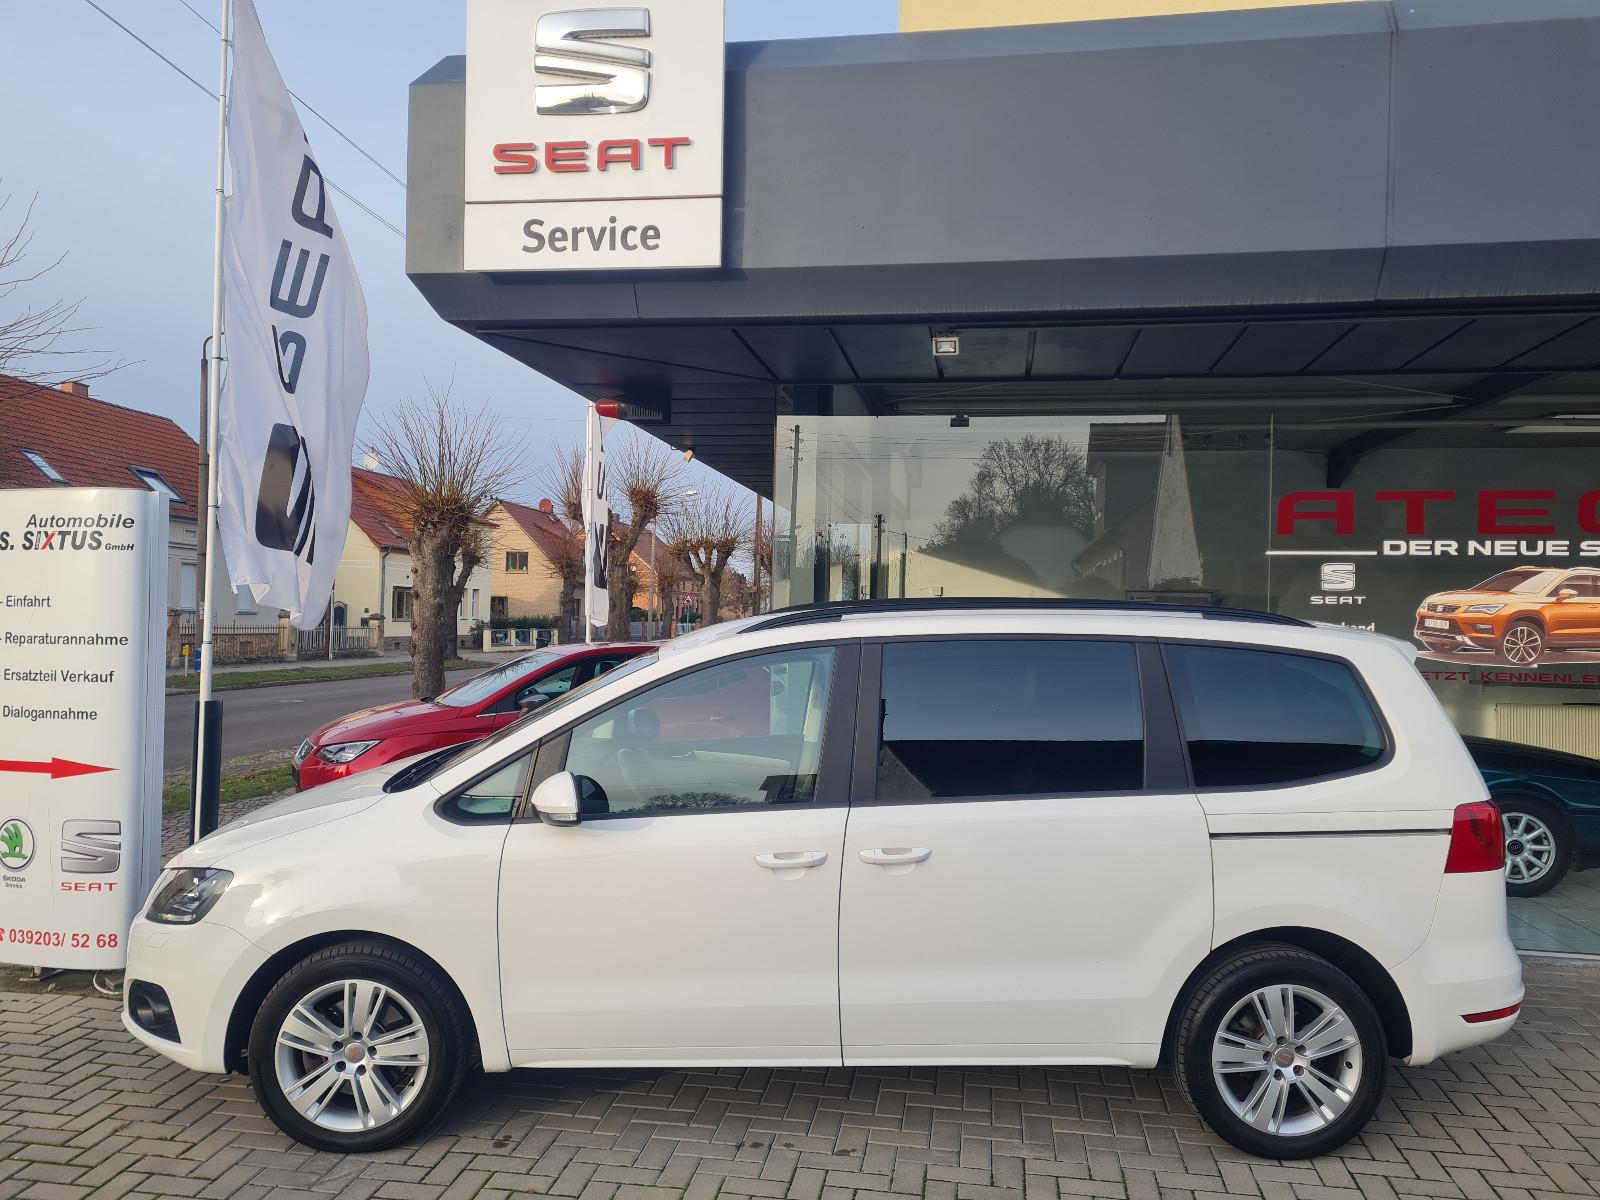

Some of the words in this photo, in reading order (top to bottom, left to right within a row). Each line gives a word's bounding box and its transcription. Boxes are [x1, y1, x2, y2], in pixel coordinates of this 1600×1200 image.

[493, 136, 692, 174] SEAT
[521, 215, 661, 253] Service
[25, 513, 135, 528] Automobile
[21, 530, 103, 550] SIXTUS
[104, 543, 134, 551] GmbH
[1383, 540, 1458, 556] DER
[1467, 540, 1570, 556] NEUE
[5, 595, 51, 607] Einfahrt
[1309, 596, 1366, 605] SEAT
[4, 631, 129, 648] Reparaturannahme
[3, 668, 57, 682] Ersatzteil
[60, 670, 115, 683] Verkauf
[1420, 671, 1470, 681] ETZT
[1480, 672, 1600, 684] KENNENLE
[2, 705, 98, 721] Dialogannahme
[60, 882, 118, 892] SEAT
[9, 928, 66, 948] 039203/
[71, 933, 90, 949] 52
[96, 933, 118, 949] 68
